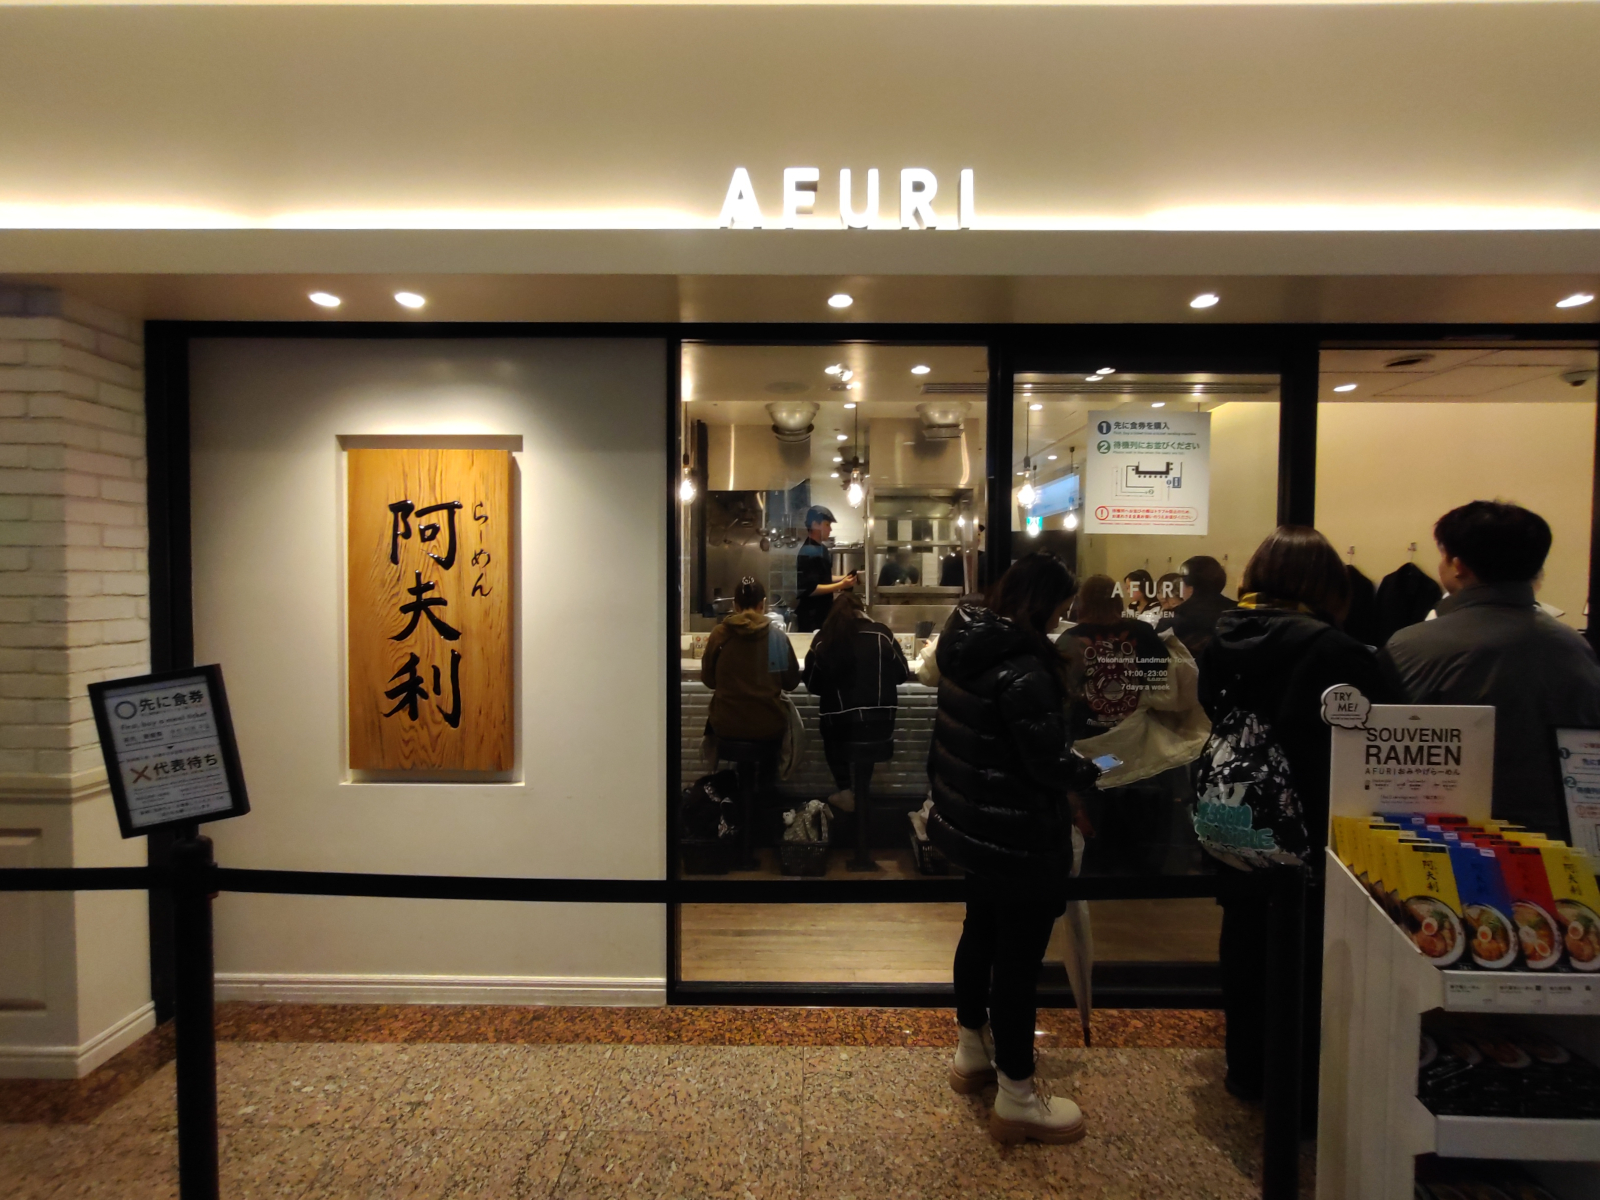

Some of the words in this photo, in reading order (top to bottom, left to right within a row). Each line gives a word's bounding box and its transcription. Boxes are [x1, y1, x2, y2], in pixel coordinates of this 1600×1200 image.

[718, 167, 975, 230] AFURI
[1113, 421, 1170, 430] 先に食券を購入
[1113, 441, 1200, 450] 待機列にお並びください
[471, 501, 493, 597] らーめん
[1110, 581, 1184, 598] AFURI
[382, 500, 463, 729] 阿夫利
[1096, 656, 1134, 664] Yokohama
[1136, 656, 1172, 664] Landmark
[1151, 683, 1171, 691] week
[139, 689, 204, 712] 先に食券
[1333, 691, 1353, 701] TRY
[1337, 703, 1358, 712] ME!
[1366, 727, 1461, 743] SOUVENIR
[1365, 744, 1462, 766] RAMEN
[153, 753, 218, 776] 代表待ち
[1422, 860, 1439, 893] 阿夫利
